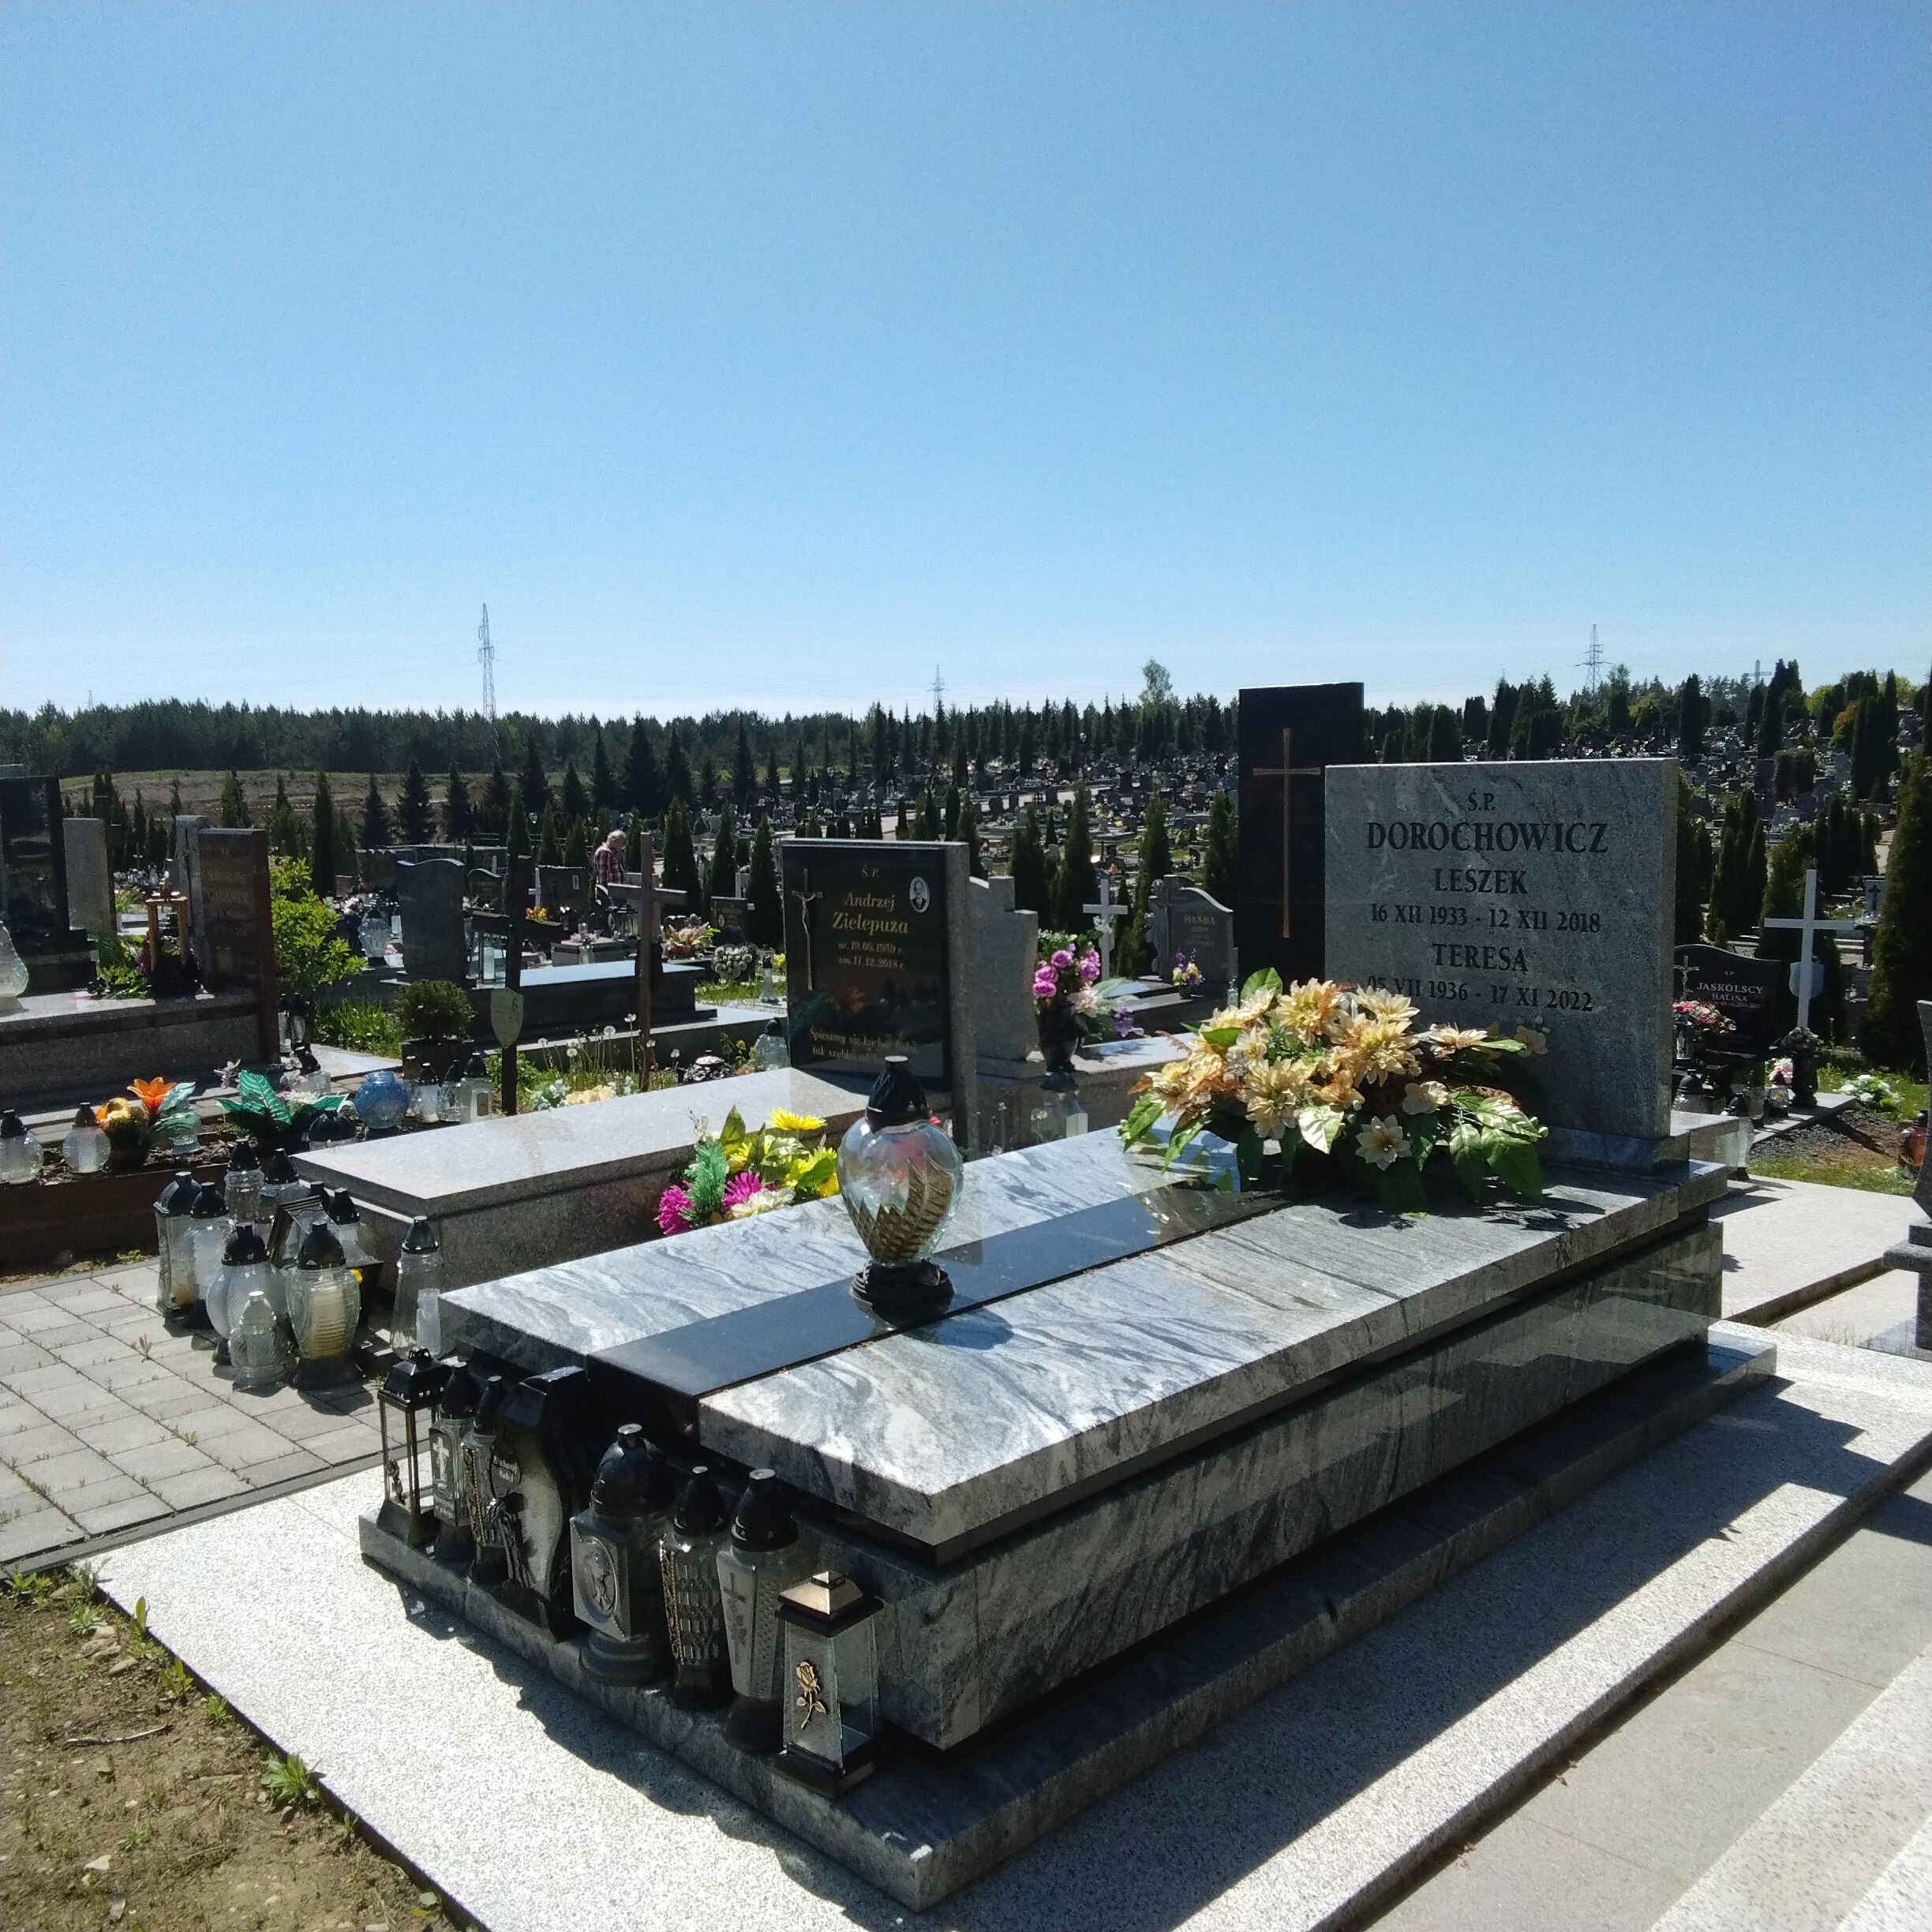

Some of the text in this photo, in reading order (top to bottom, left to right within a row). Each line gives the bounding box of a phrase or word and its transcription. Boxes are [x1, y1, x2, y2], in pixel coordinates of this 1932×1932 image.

[1366, 822, 1609, 854] DOROCHOWICZ
[1433, 867, 1529, 894] LESZEK
[844, 892, 896, 912] Andrzej
[1370, 903, 1387, 922] 16
[1394, 904, 1421, 923] XII
[1429, 905, 1468, 927] 1933
[1489, 908, 1509, 928] 12
[1517, 910, 1548, 930] XII
[1556, 912, 1601, 933] 2018
[1432, 942, 1530, 972] TERESA
[1394, 977, 1421, 997] VII
[1428, 980, 1469, 1001] 1936
[1491, 984, 1507, 1004] 17
[1515, 987, 1539, 1007] XI
[1545, 989, 1593, 1012] 2022
[1697, 982, 1764, 994] JASKÓLSCY
